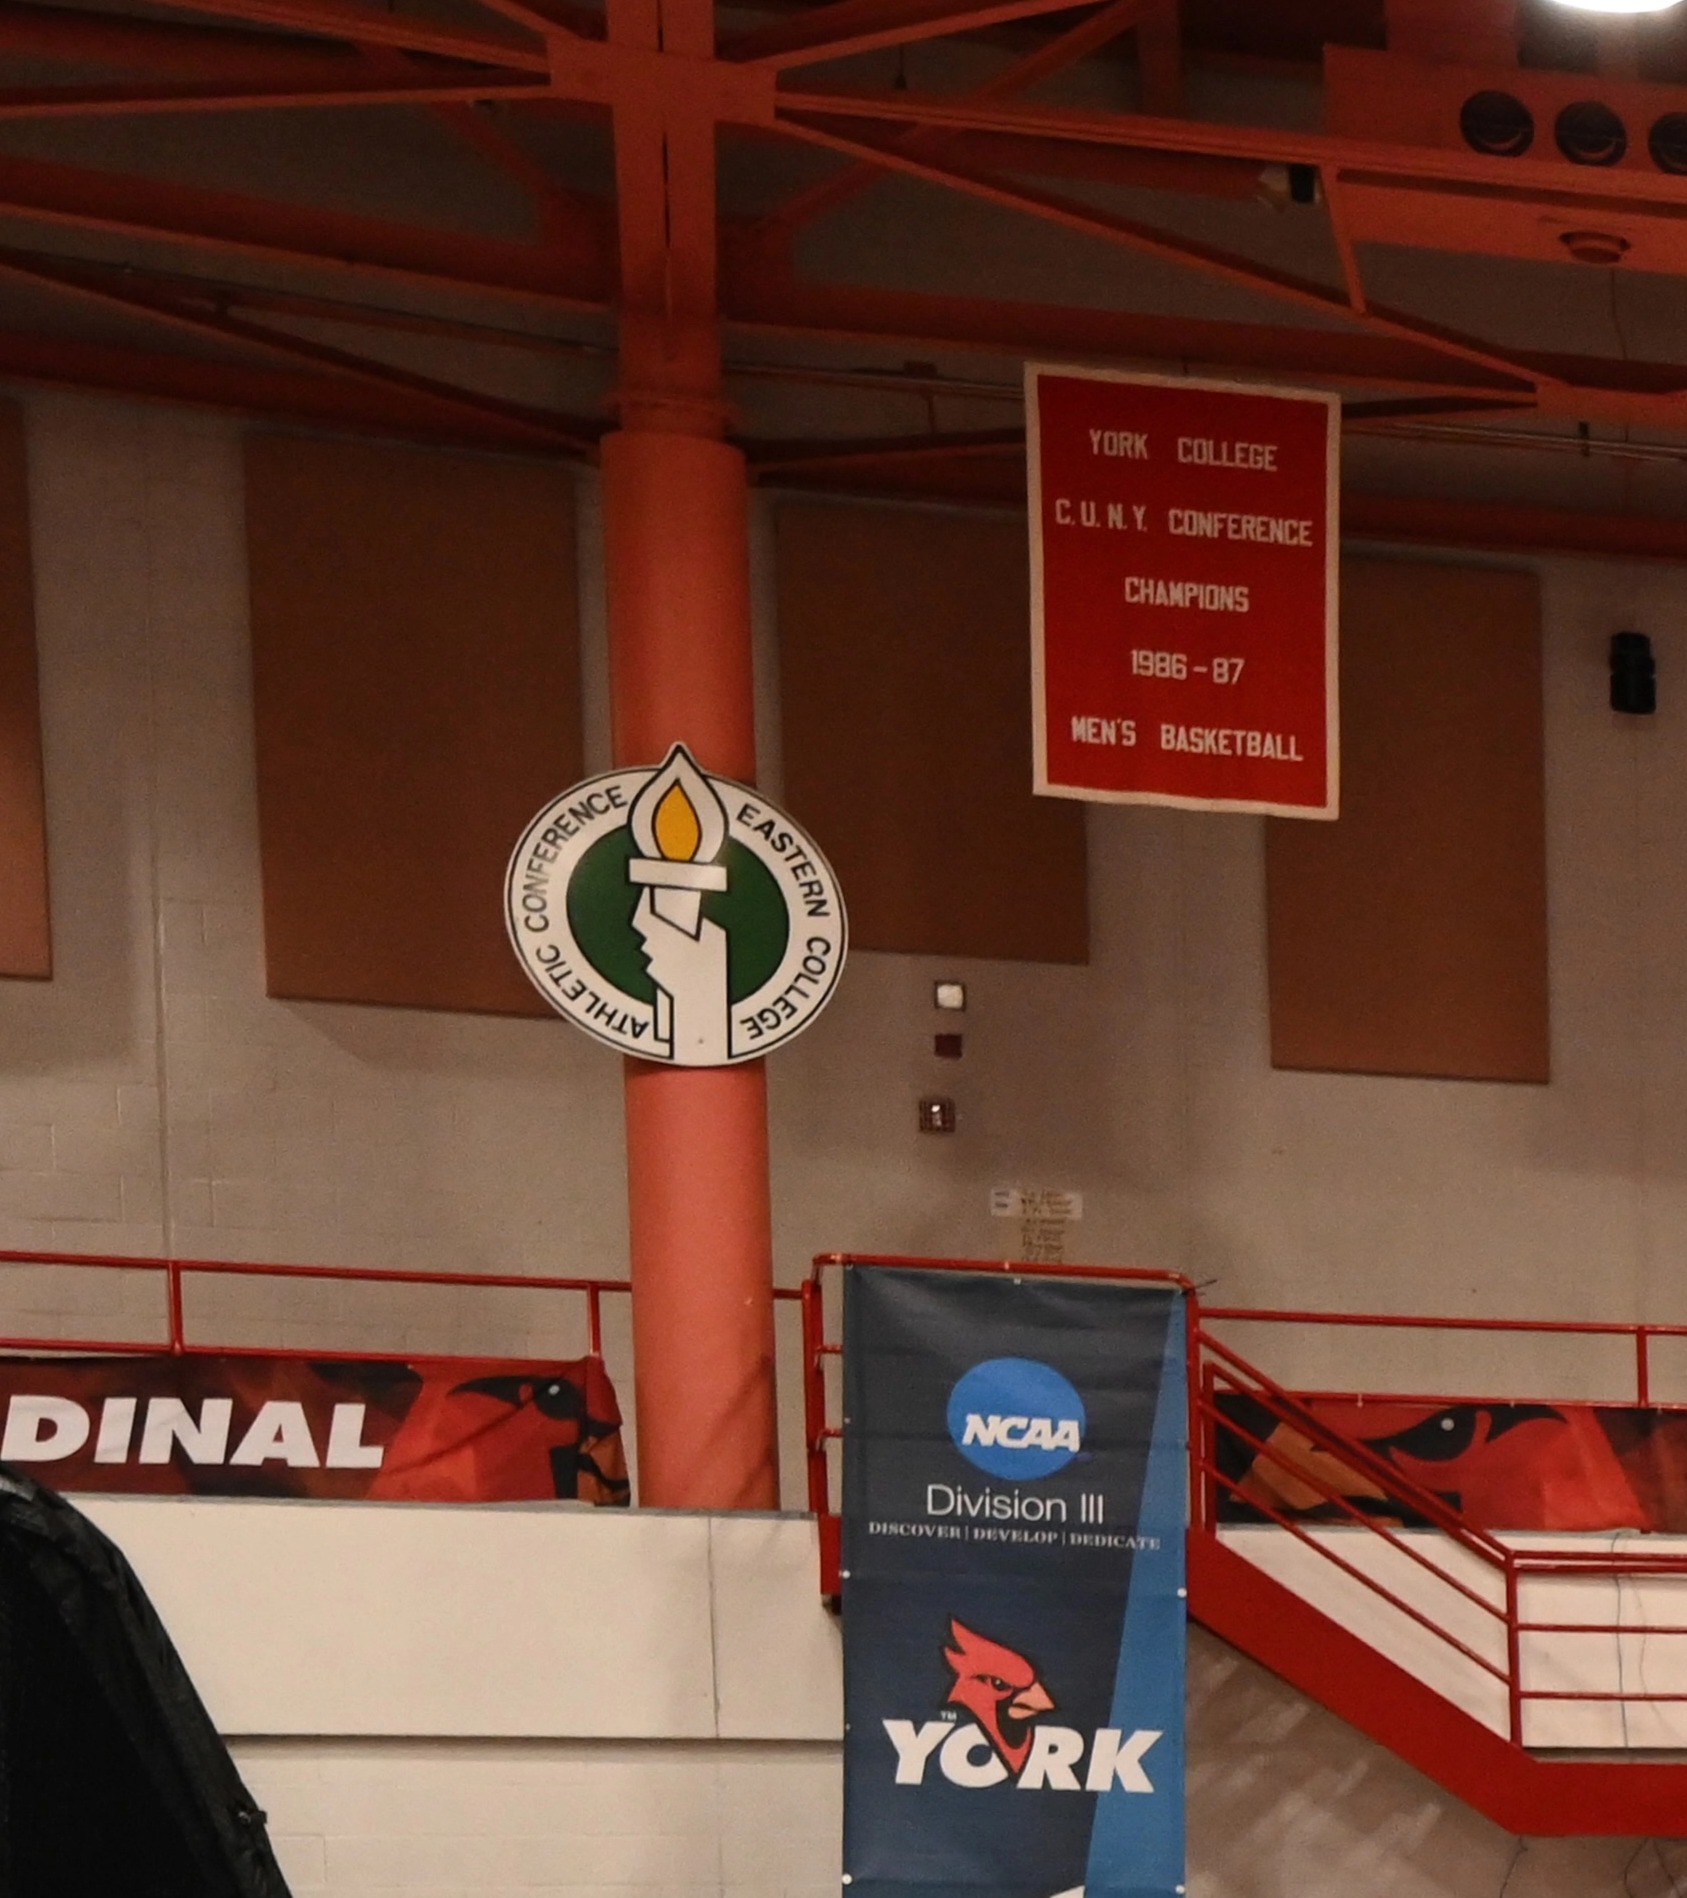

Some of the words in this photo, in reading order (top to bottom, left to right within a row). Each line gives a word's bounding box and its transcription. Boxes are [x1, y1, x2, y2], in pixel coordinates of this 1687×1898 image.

[1089, 429, 1149, 460] YORK
[1177, 437, 1277, 472] COLLEGE
[1169, 509, 1313, 547] CONFERENCE
[1125, 576, 1249, 612] CHAMPIONS
[1072, 715, 1136, 747] MEN'S
[1161, 724, 1303, 761] BASKETBALL
[521, 784, 629, 933] CONFERENCE
[735, 803, 831, 918] EASTERN
[535, 943, 651, 1039] ATHLETIC
[739, 936, 831, 1040] COLLEGE
[0, 1395, 384, 1468] DINAL
[962, 1413, 1081, 1453] NCAA
[927, 1483, 1067, 1523] Division
[1080, 1493, 1104, 1524] III
[868, 1521, 961, 1539] DISCOVER
[973, 1527, 1058, 1545] DEVELOP
[1070, 1532, 1162, 1550] DEDICATE
[881, 1718, 1164, 1795] YORK
